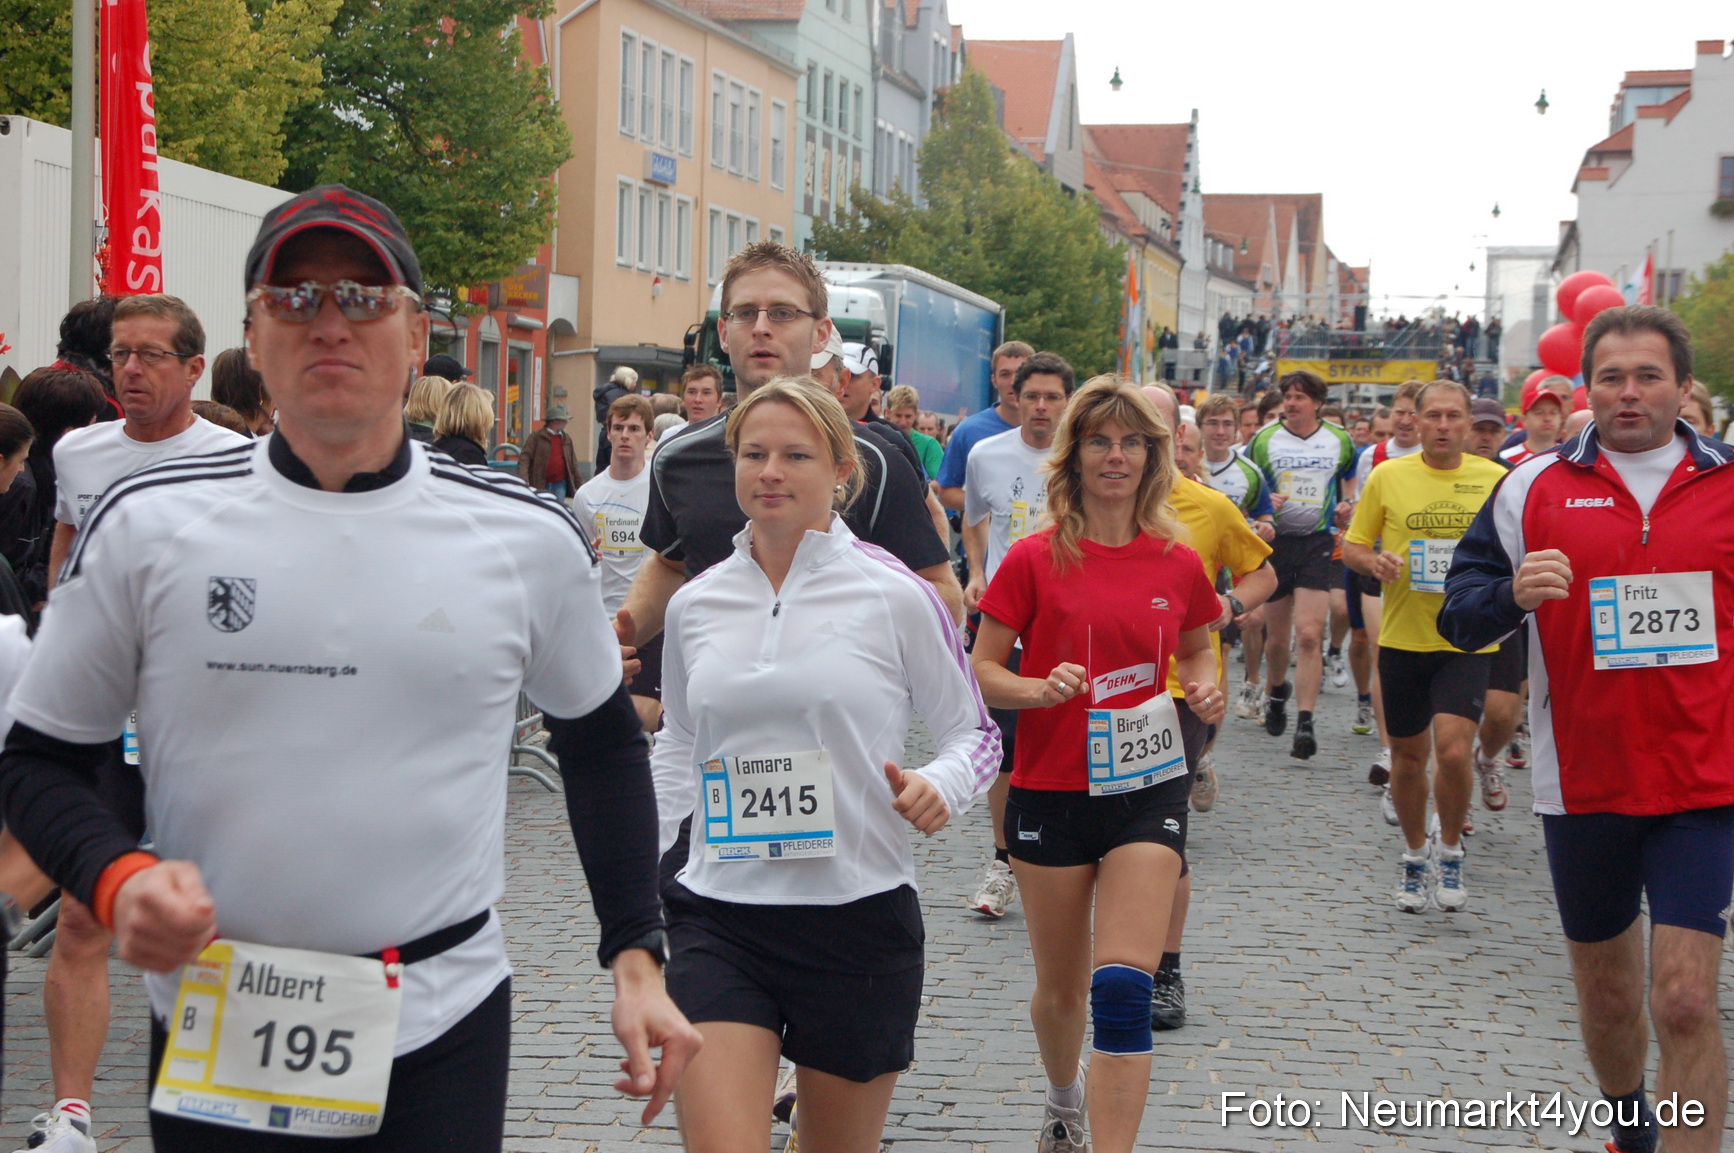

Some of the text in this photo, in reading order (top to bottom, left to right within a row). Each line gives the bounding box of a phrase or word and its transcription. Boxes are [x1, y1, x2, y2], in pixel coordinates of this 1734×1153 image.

[1328, 364, 1383, 378] START
[1296, 487, 1317, 496] 412
[1565, 497, 1615, 508] LEGEA
[605, 517, 639, 526] Ferdinand
[611, 530, 635, 542] 694
[1624, 584, 1659, 601] Fritz
[1599, 611, 1607, 624] C
[1628, 608, 1701, 635] 2873
[1668, 650, 1715, 661] PFLEIDERER
[206, 661, 358, 678] www.sun.nuernberg.de
[1107, 673, 1137, 690] DEHN
[1117, 714, 1150, 733] Birgit
[1094, 742, 1101, 755] C
[1120, 728, 1173, 763] 2330
[734, 756, 793, 775] Tamara
[1153, 762, 1185, 779] PFLEIDERER
[712, 788, 720, 804] B
[741, 784, 818, 818] 2415
[783, 839, 834, 851] PFLEIDERER
[238, 961, 327, 1003] Albert
[181, 1006, 198, 1031] B
[252, 1020, 355, 1076] 195
[294, 1107, 378, 1127] PFLEIDERER
